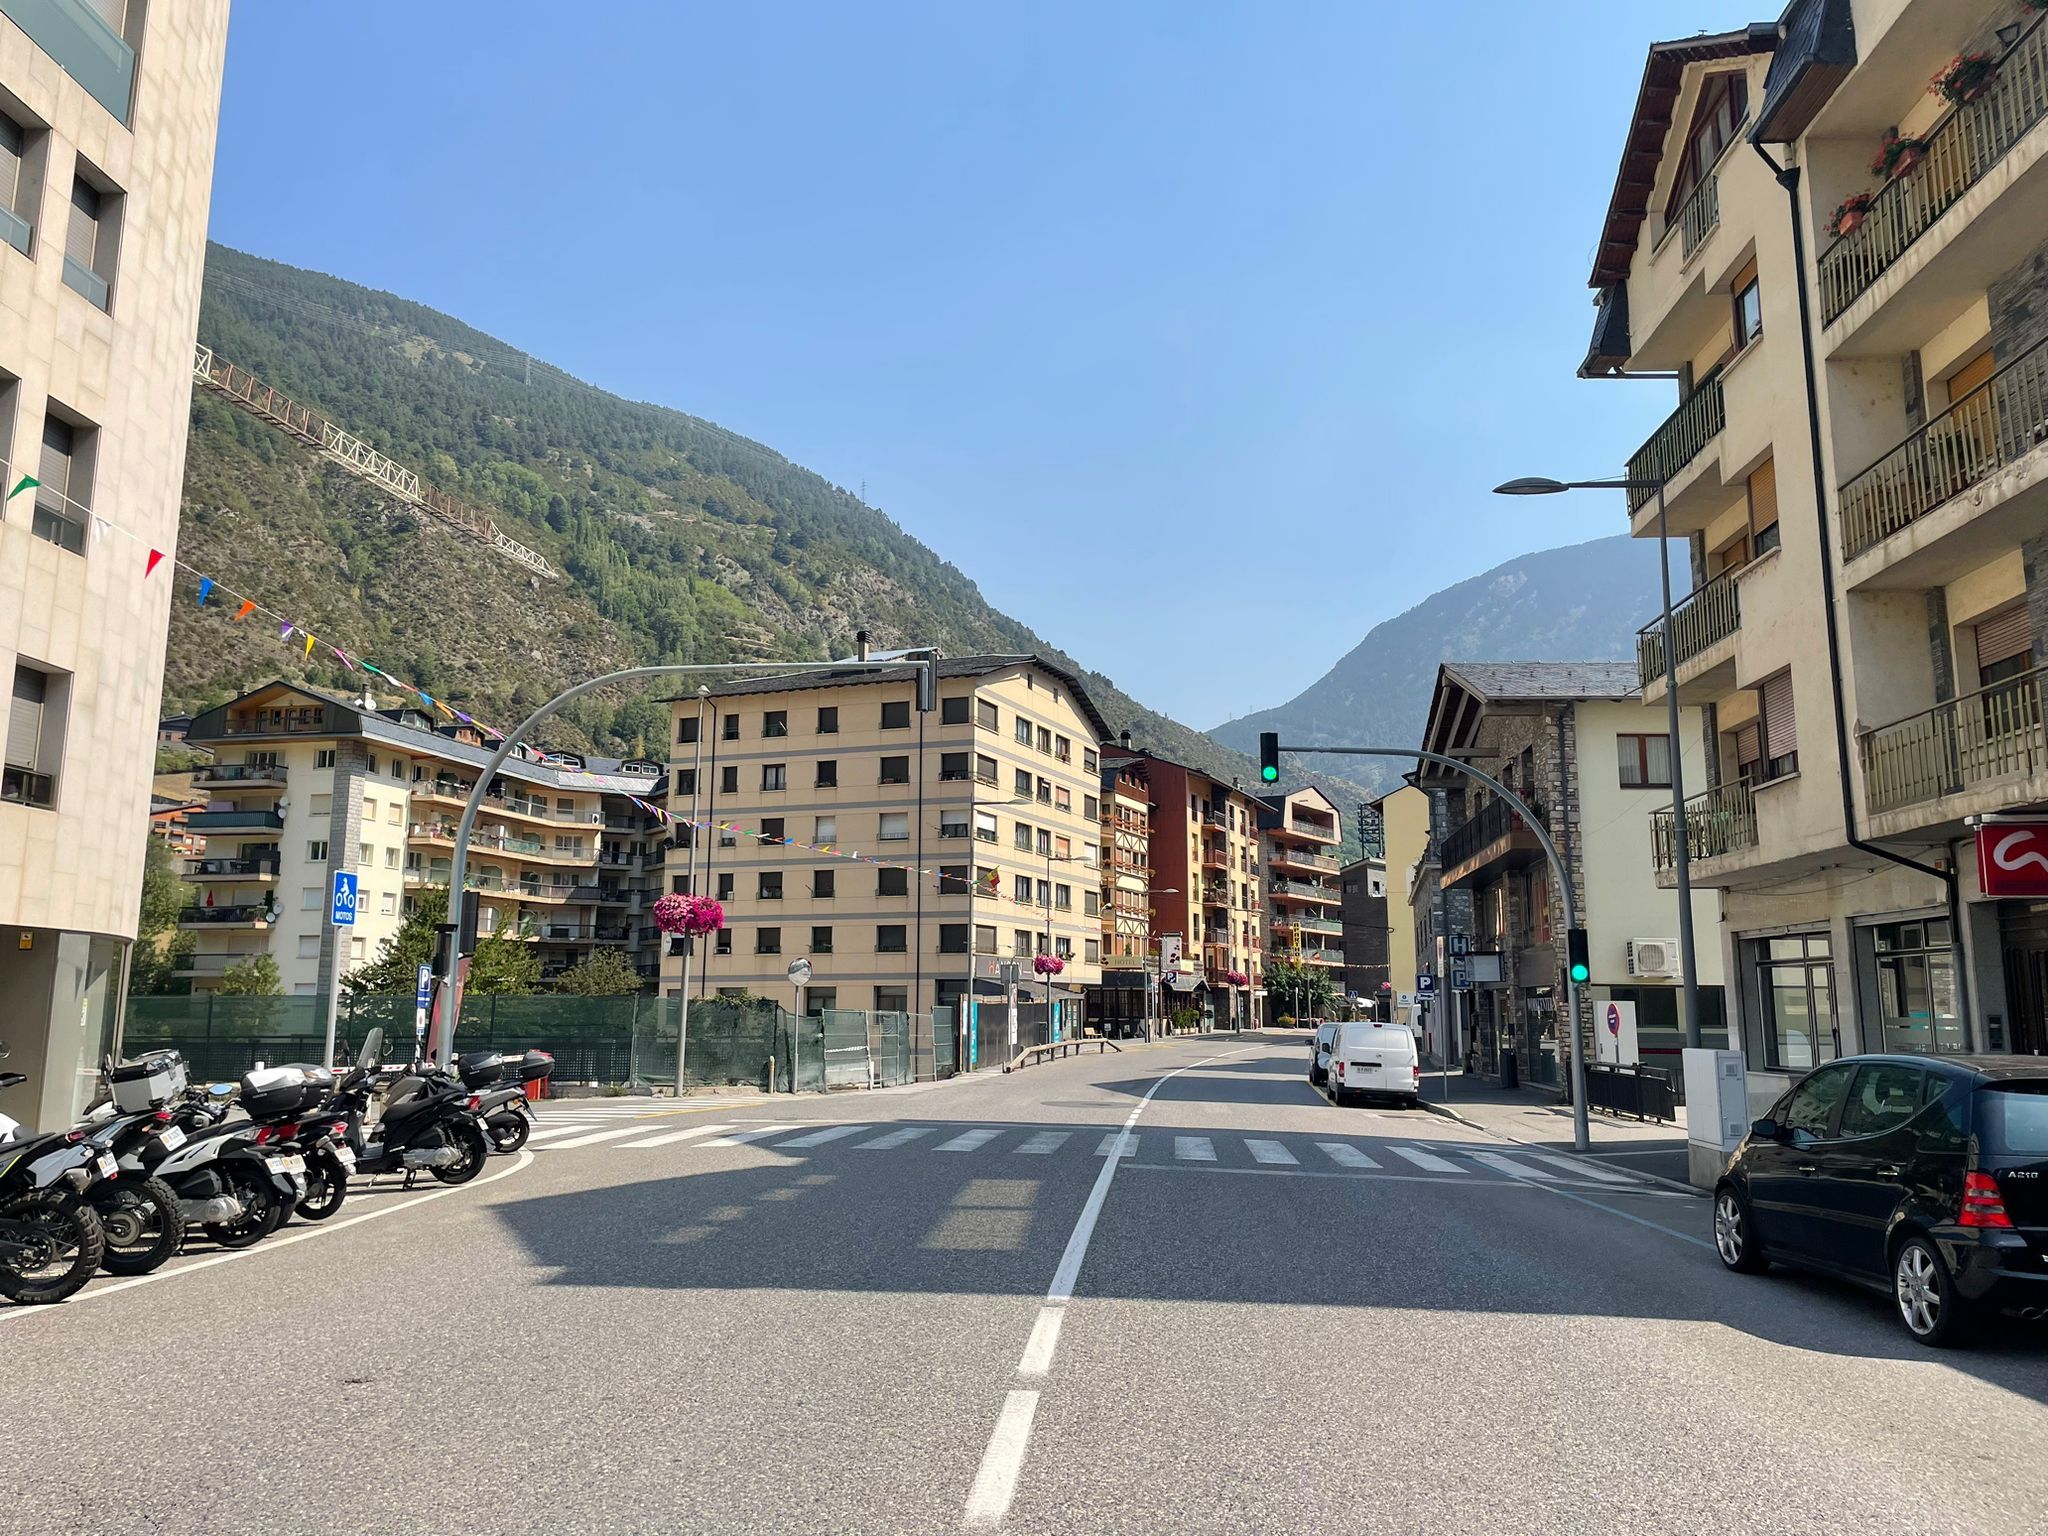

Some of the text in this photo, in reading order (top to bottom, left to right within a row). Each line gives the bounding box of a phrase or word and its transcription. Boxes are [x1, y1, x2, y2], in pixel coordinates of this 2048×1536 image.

[335, 911, 353, 921] MOTOS
[421, 969, 429, 988] P
[1167, 972, 1175, 982] P
[1420, 976, 1432, 989] P
